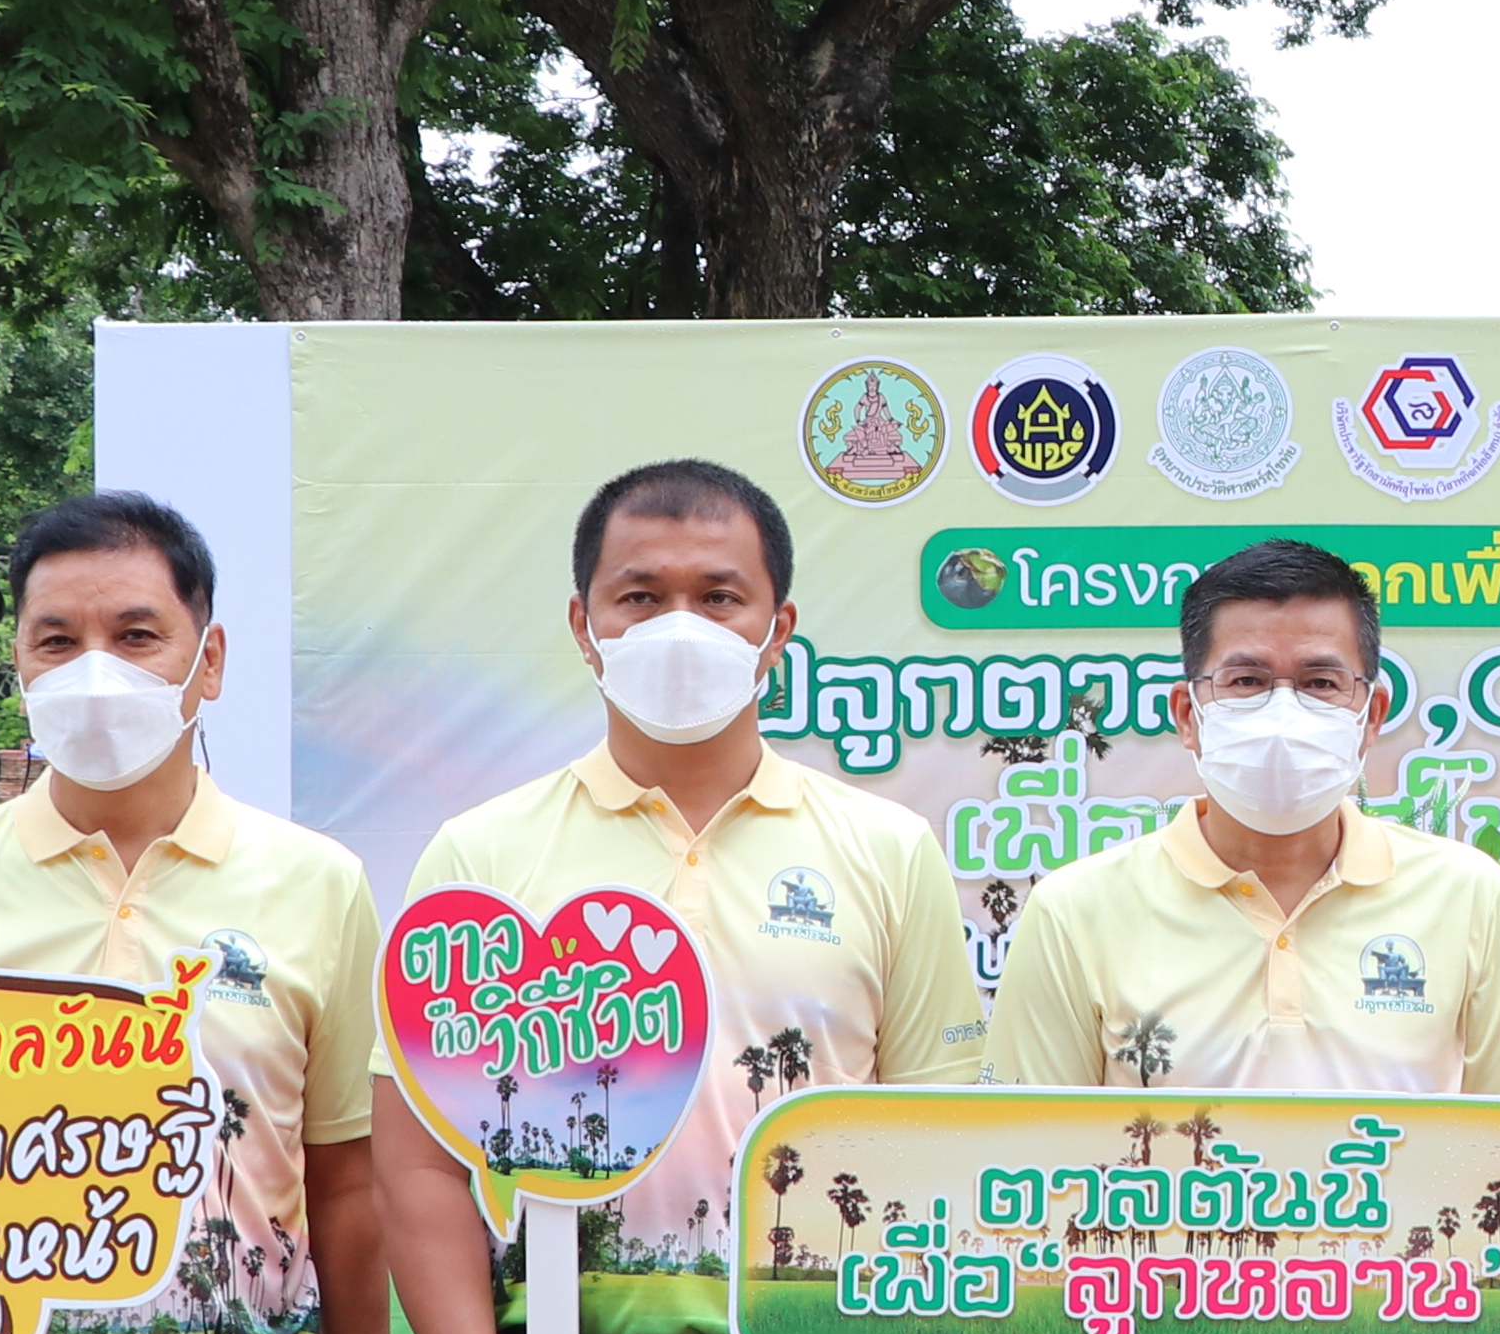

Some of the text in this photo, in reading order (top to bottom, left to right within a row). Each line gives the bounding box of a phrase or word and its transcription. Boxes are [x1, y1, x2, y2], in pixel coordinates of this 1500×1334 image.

[1013, 547, 1220, 607] โครงก
[401, 913, 523, 993] ตาล
[976, 1114, 1404, 1234] ตาลต้นนี้
